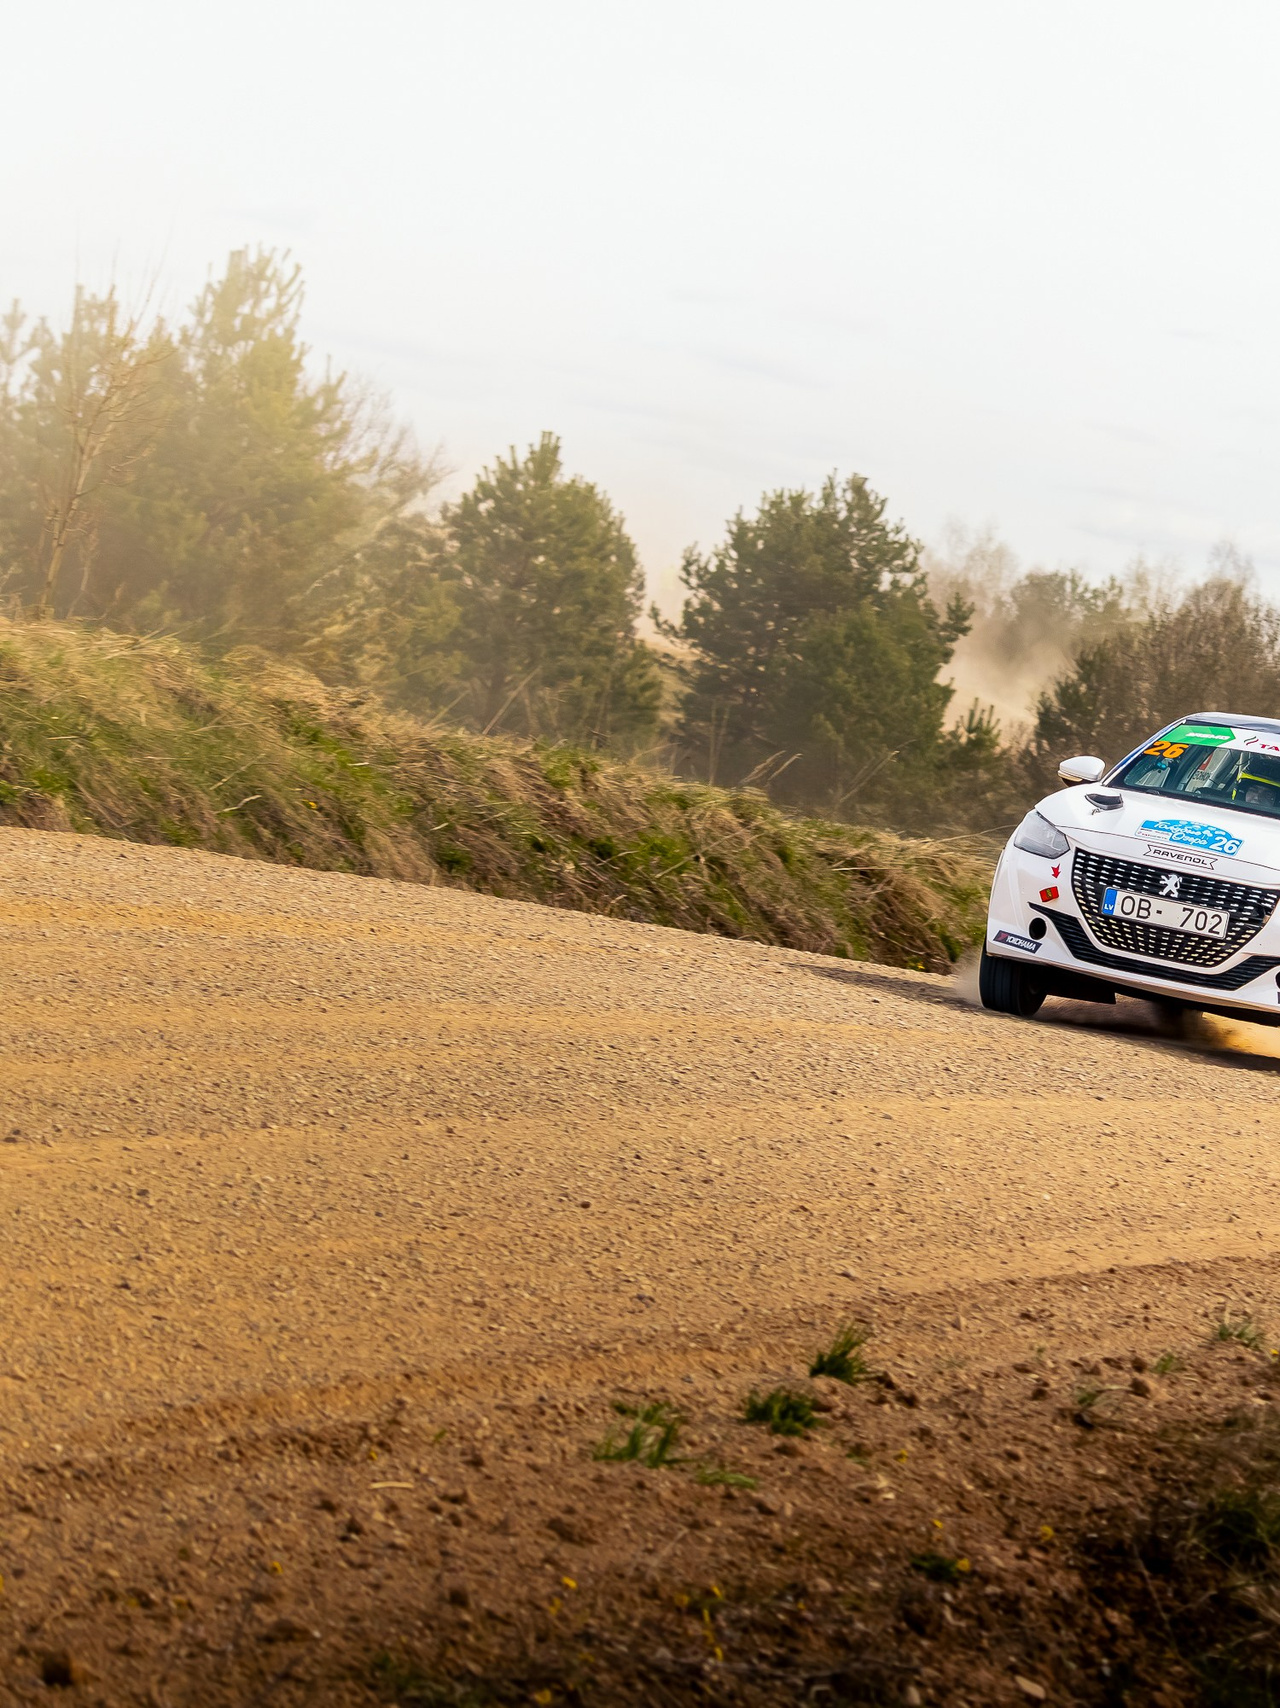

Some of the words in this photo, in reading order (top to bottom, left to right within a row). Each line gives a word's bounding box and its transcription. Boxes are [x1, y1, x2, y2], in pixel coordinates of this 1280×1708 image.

[1143, 740, 1189, 759] 26
[1209, 836, 1241, 854] 26
[1153, 848, 1208, 866] RAVENOL
[1104, 903, 1114, 911] LV
[1179, 907, 1223, 935] 702
[1006, 935, 1037, 951] YOKOHAMA
